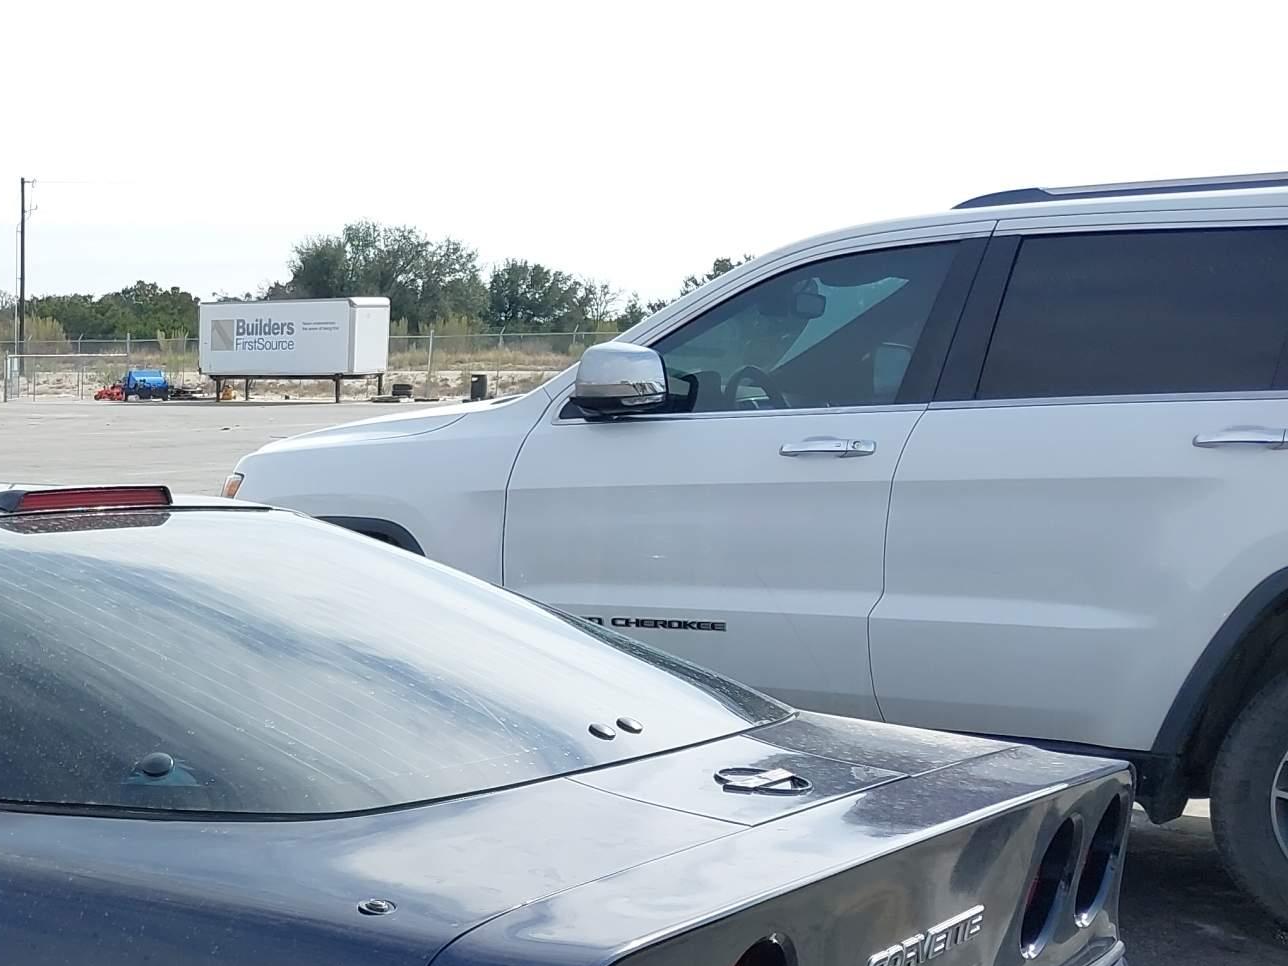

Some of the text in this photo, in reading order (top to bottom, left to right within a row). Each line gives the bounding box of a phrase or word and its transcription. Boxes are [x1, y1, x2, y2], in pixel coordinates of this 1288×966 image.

[236, 318, 295, 336] Builders
[235, 338, 295, 351] FirstSource
[611, 617, 727, 632] CHEROKEE
